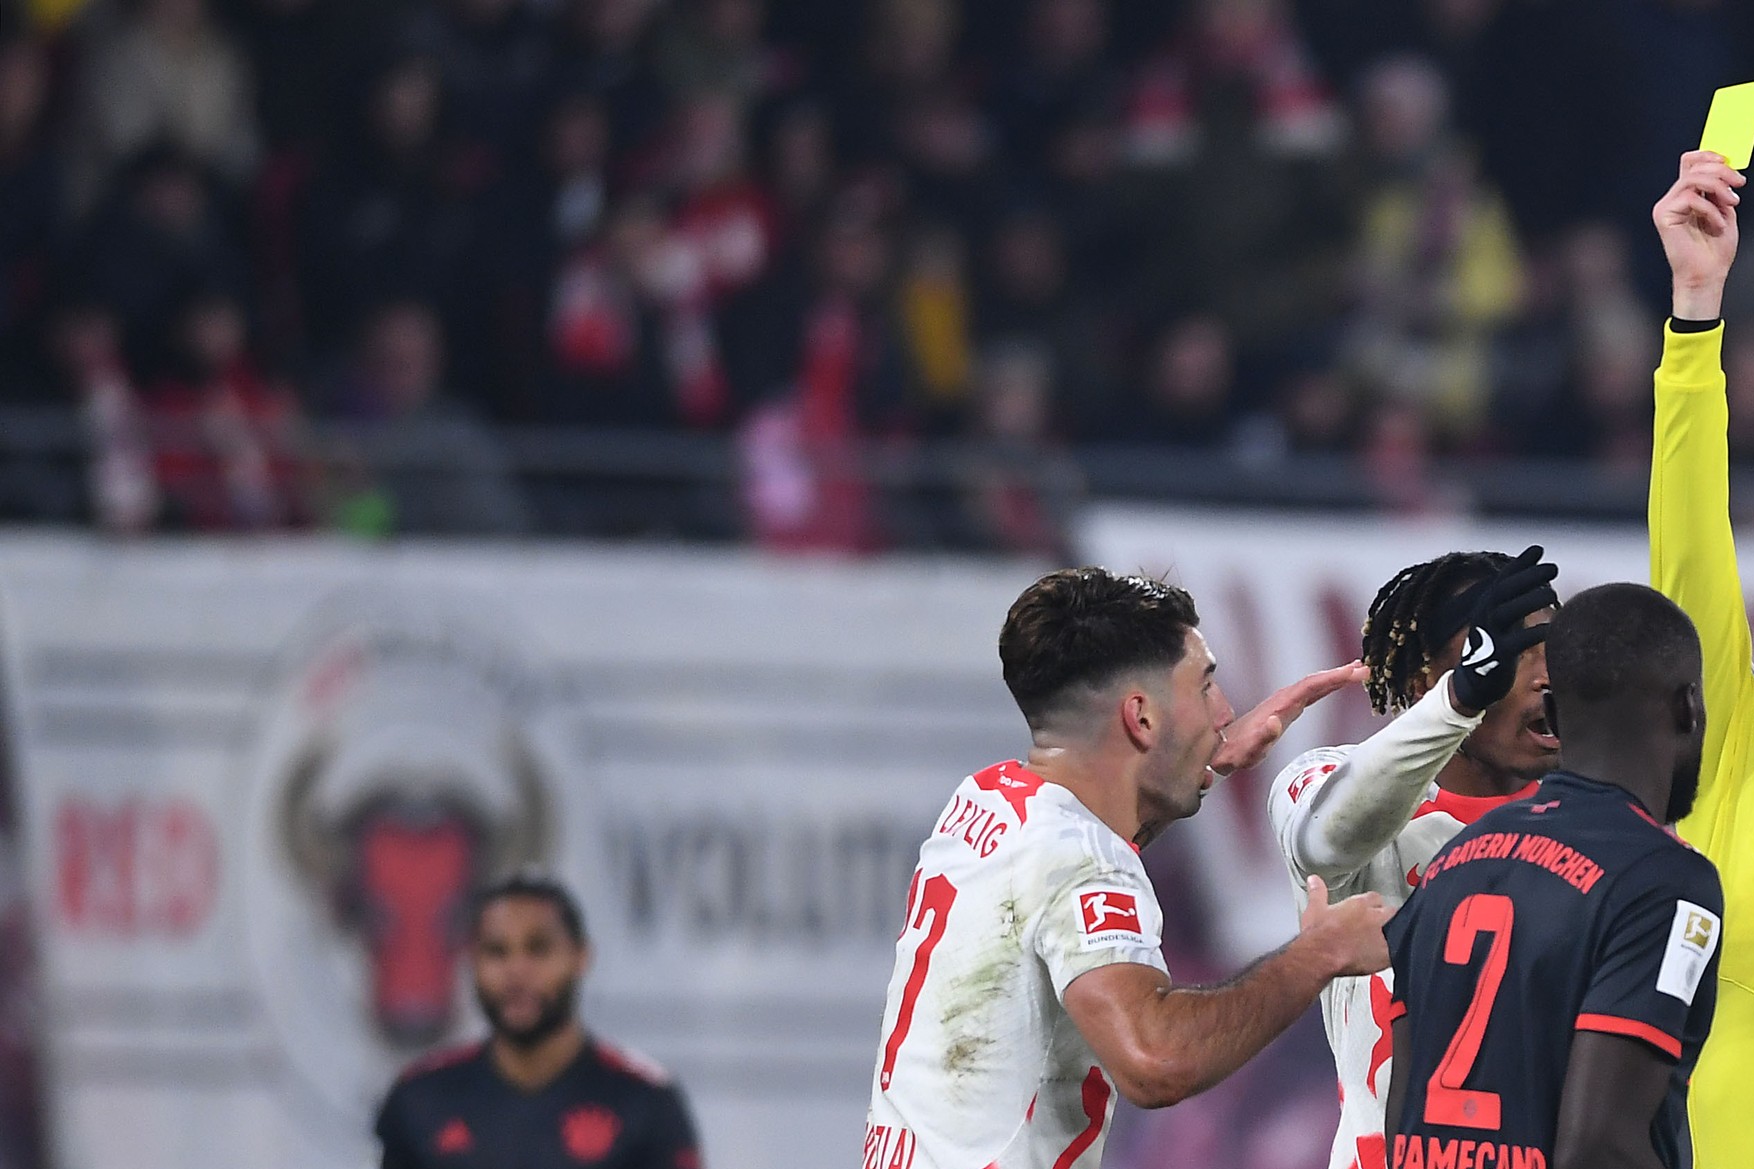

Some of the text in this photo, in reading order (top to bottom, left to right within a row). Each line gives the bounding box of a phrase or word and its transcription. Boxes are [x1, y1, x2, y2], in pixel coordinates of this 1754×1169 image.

[1443, 832, 1520, 872] BAYERN
[1087, 932, 1145, 947] BUNDESLIGA
[1424, 893, 1515, 1131] 2
